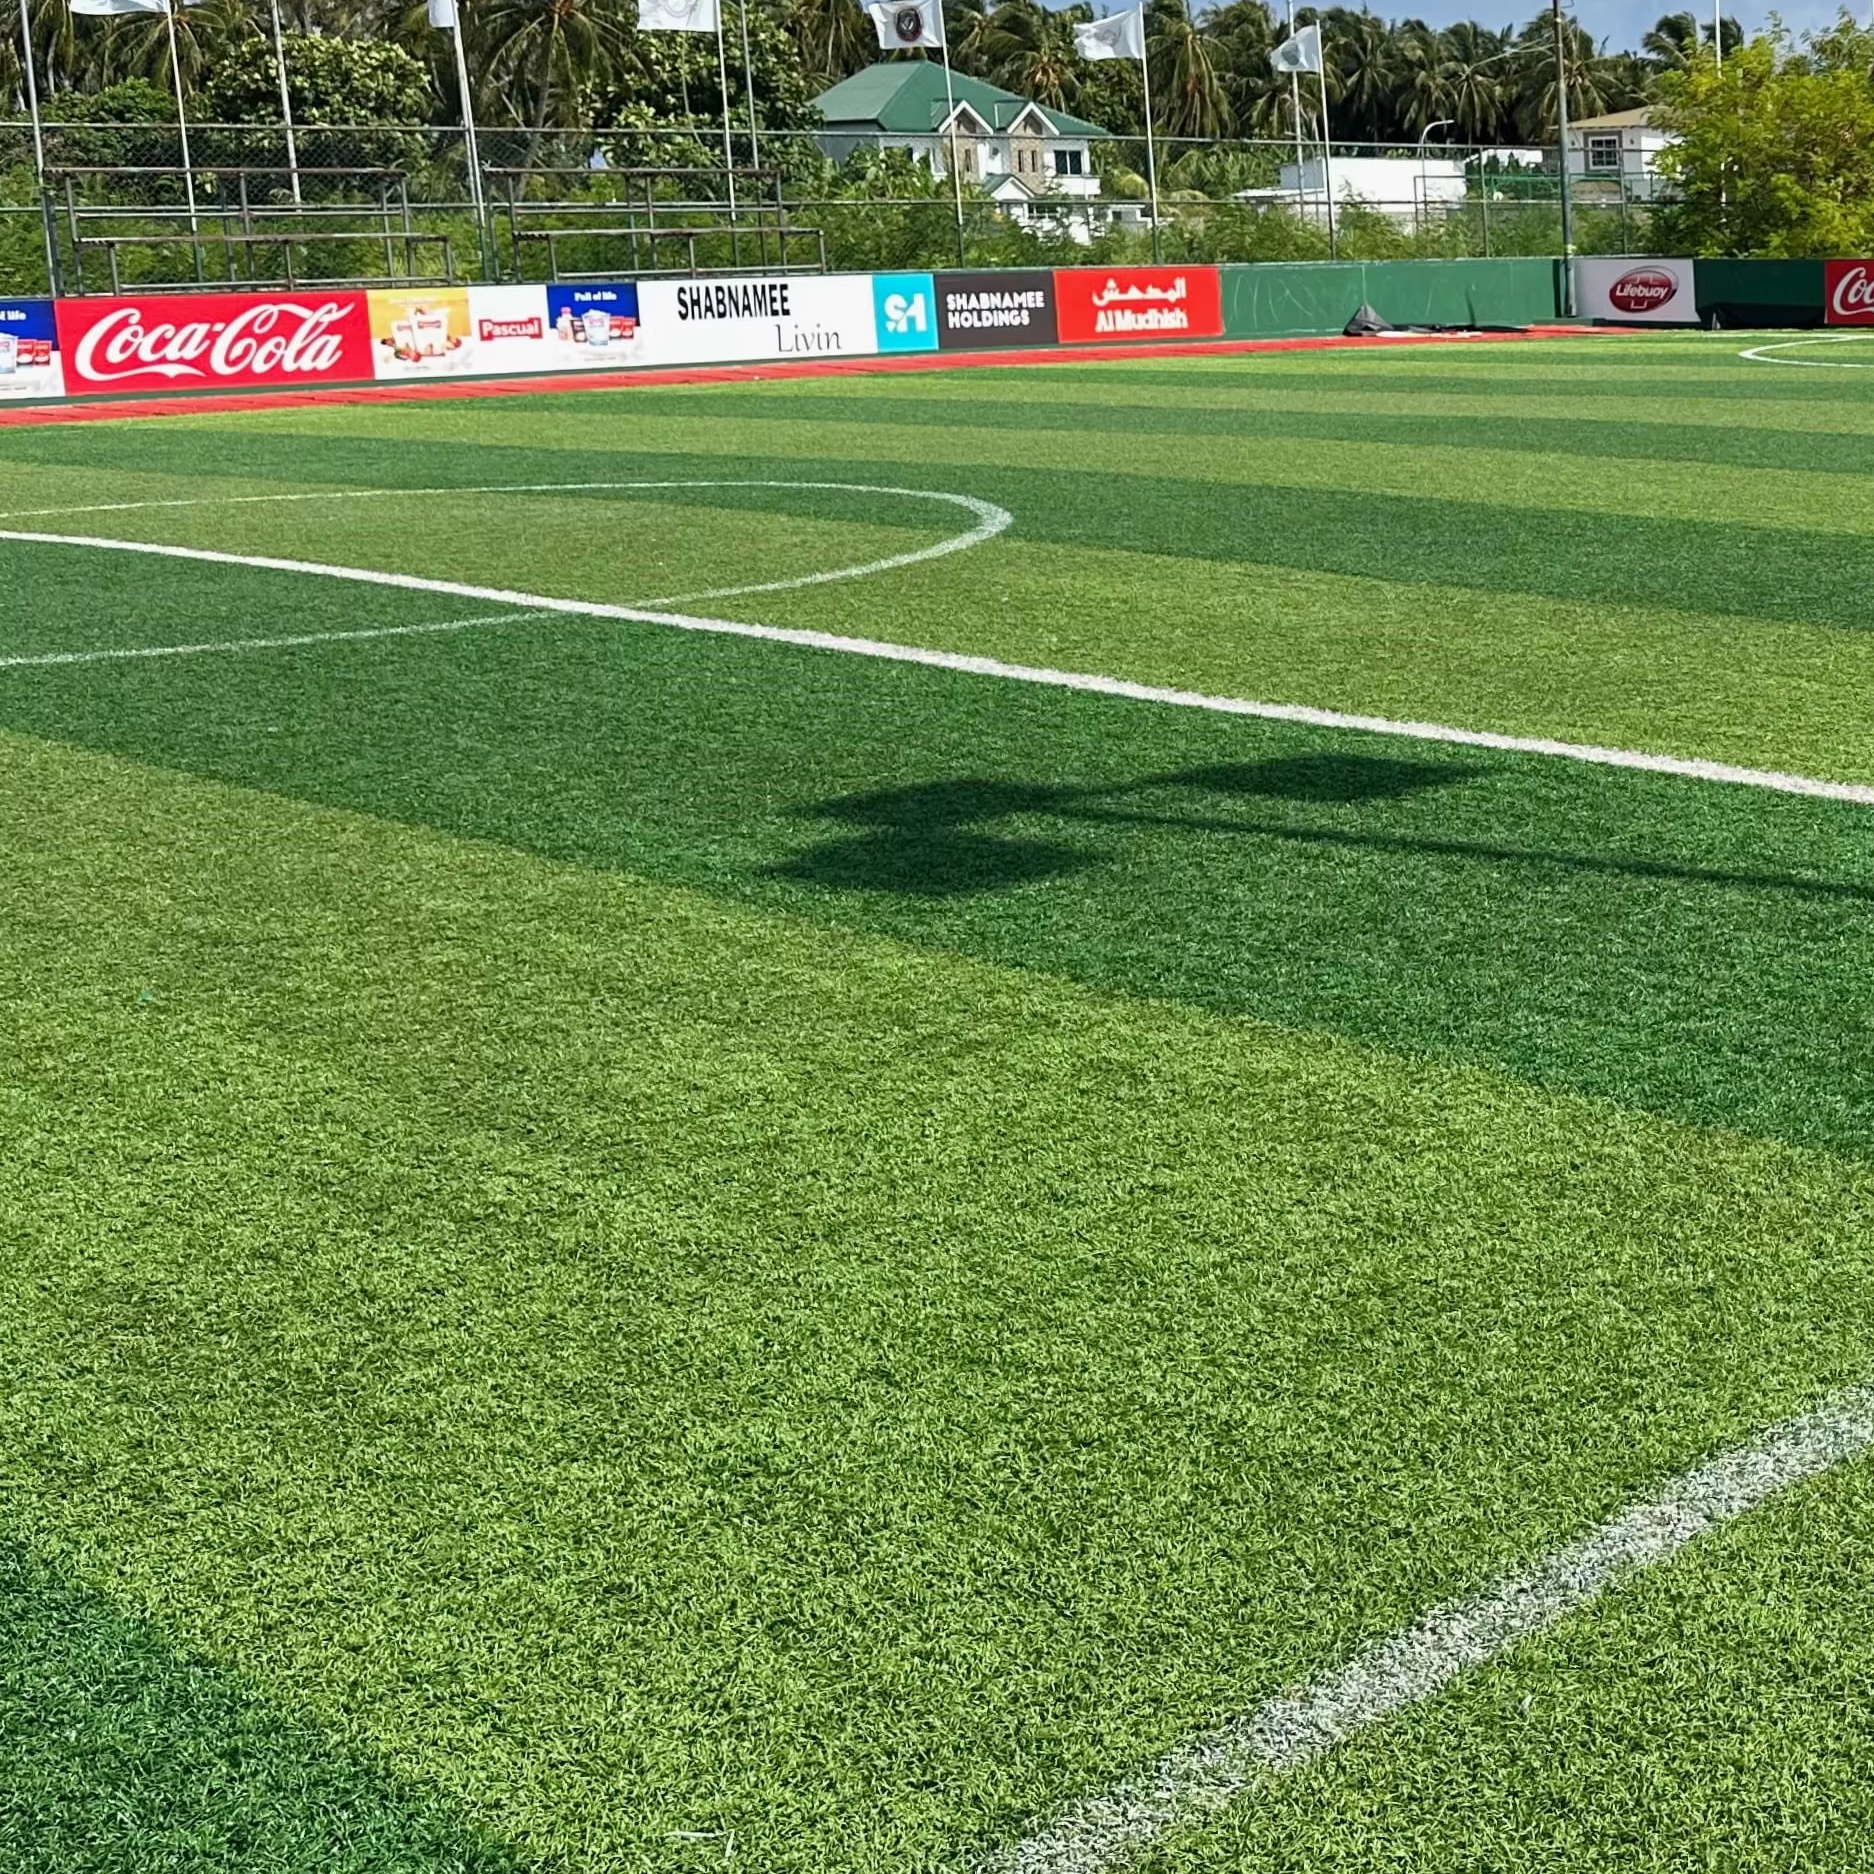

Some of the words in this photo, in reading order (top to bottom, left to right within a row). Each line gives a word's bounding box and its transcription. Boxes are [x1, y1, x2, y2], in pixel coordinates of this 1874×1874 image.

[677, 284, 790, 321] SHABNAMEE
[946, 291, 1045, 311] SHABNAMEE
[1092, 276, 1187, 307] المدهش
[1616, 283, 1668, 299] Lifebuoy
[482, 320, 540, 337] Pascual
[948, 309, 1030, 329] HOLDINGS
[1095, 309, 1115, 333] Al
[1115, 307, 1188, 331] Mudhish
[75, 302, 355, 381] Coca-Cola
[774, 323, 843, 352] Livin
